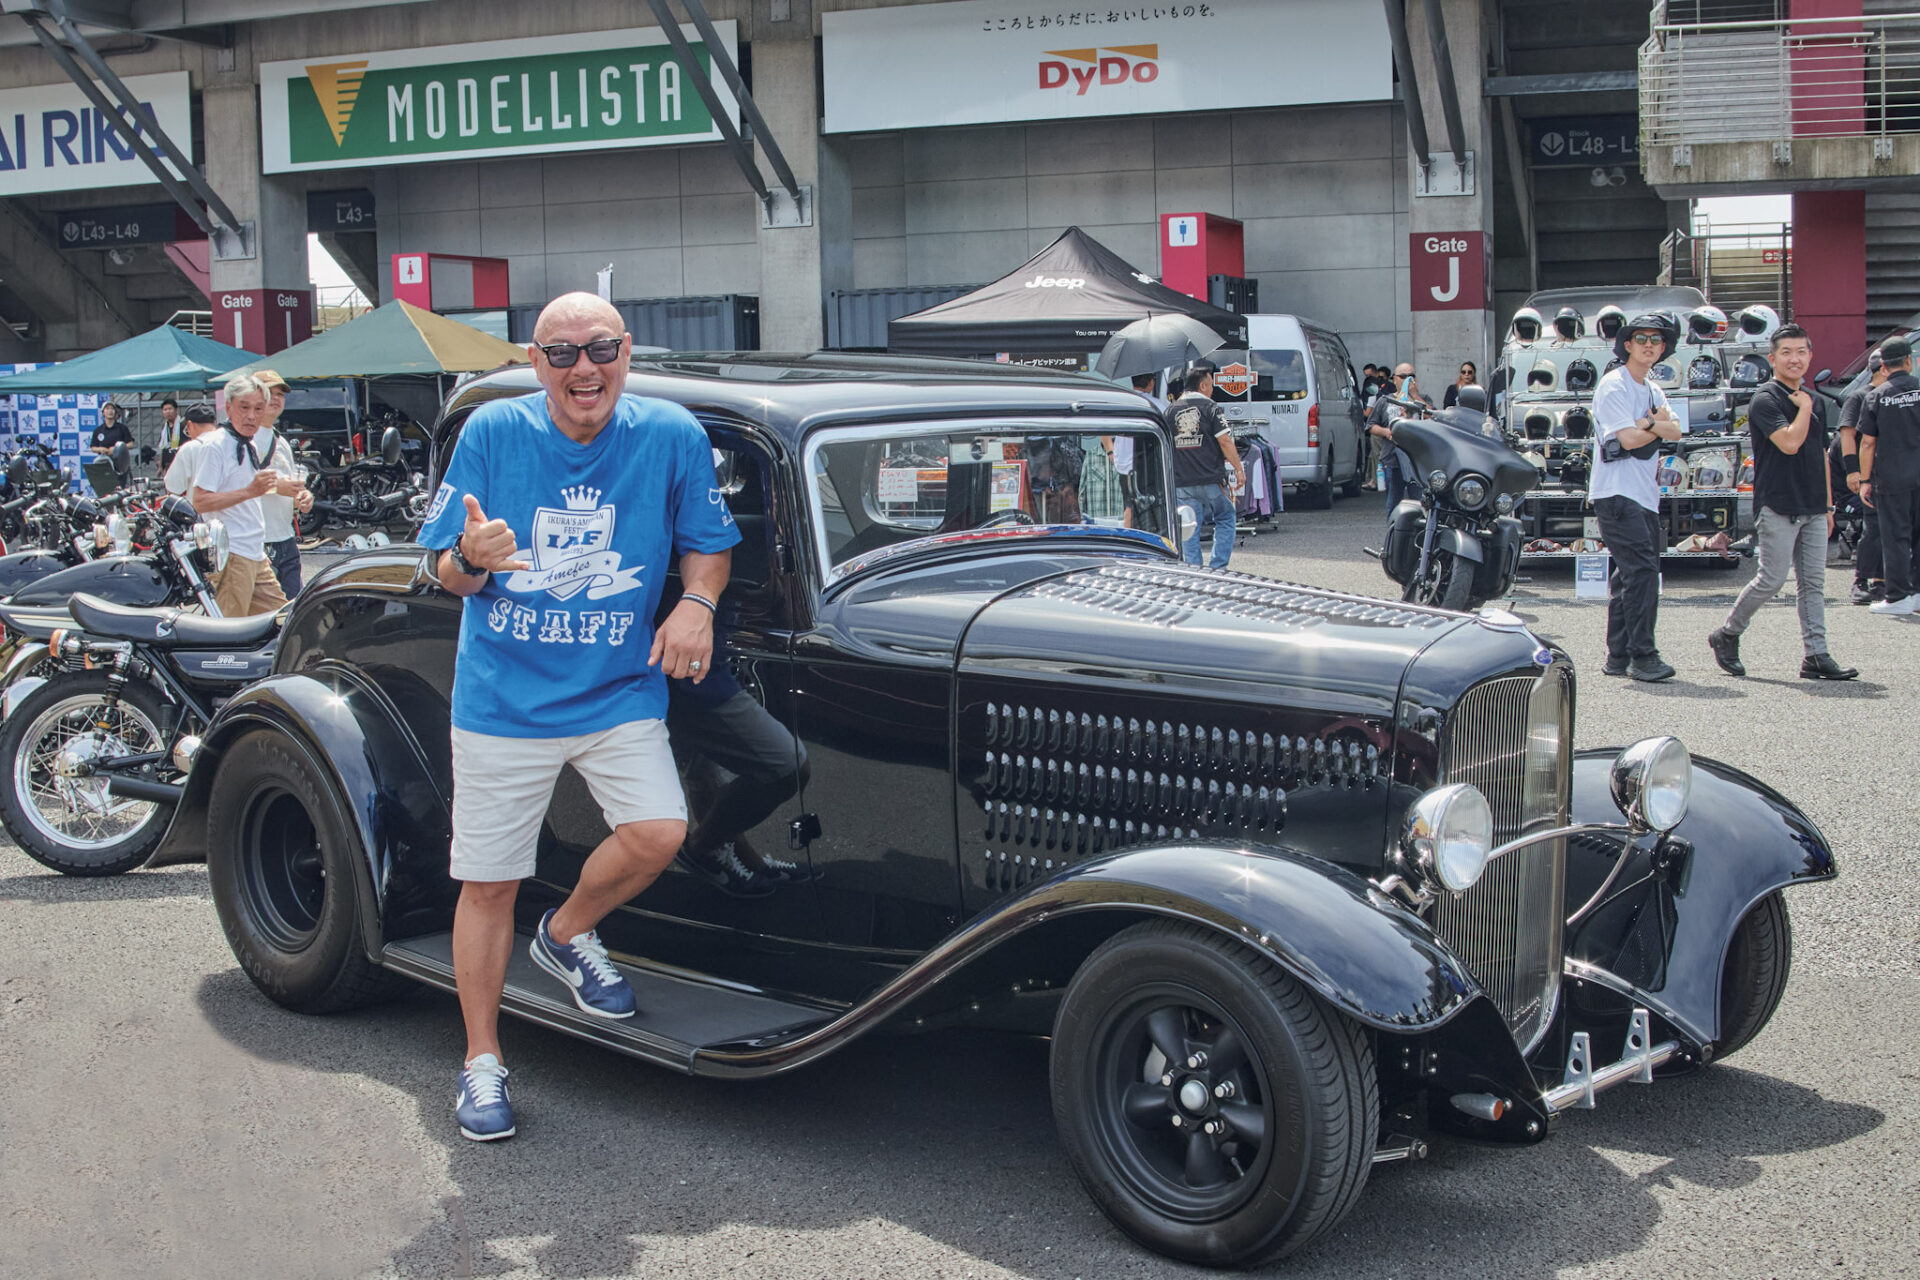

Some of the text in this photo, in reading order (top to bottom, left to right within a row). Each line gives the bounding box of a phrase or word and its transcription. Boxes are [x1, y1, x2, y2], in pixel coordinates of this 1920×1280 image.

[1039, 57, 1159, 96] DyDo
[387, 60, 682, 143] MODELLISTA
[1424, 236, 1468, 253] Gate
[1025, 275, 1086, 290] Jeep
[1430, 256, 1459, 302] J
[222, 294, 252, 308] Gate
[277, 293, 298, 307] Gate
[1272, 404, 1299, 414] NUMAZU
[547, 515, 577, 527] IKURA'S
[546, 530, 603, 549] IAF
[488, 597, 634, 646] STAFF
